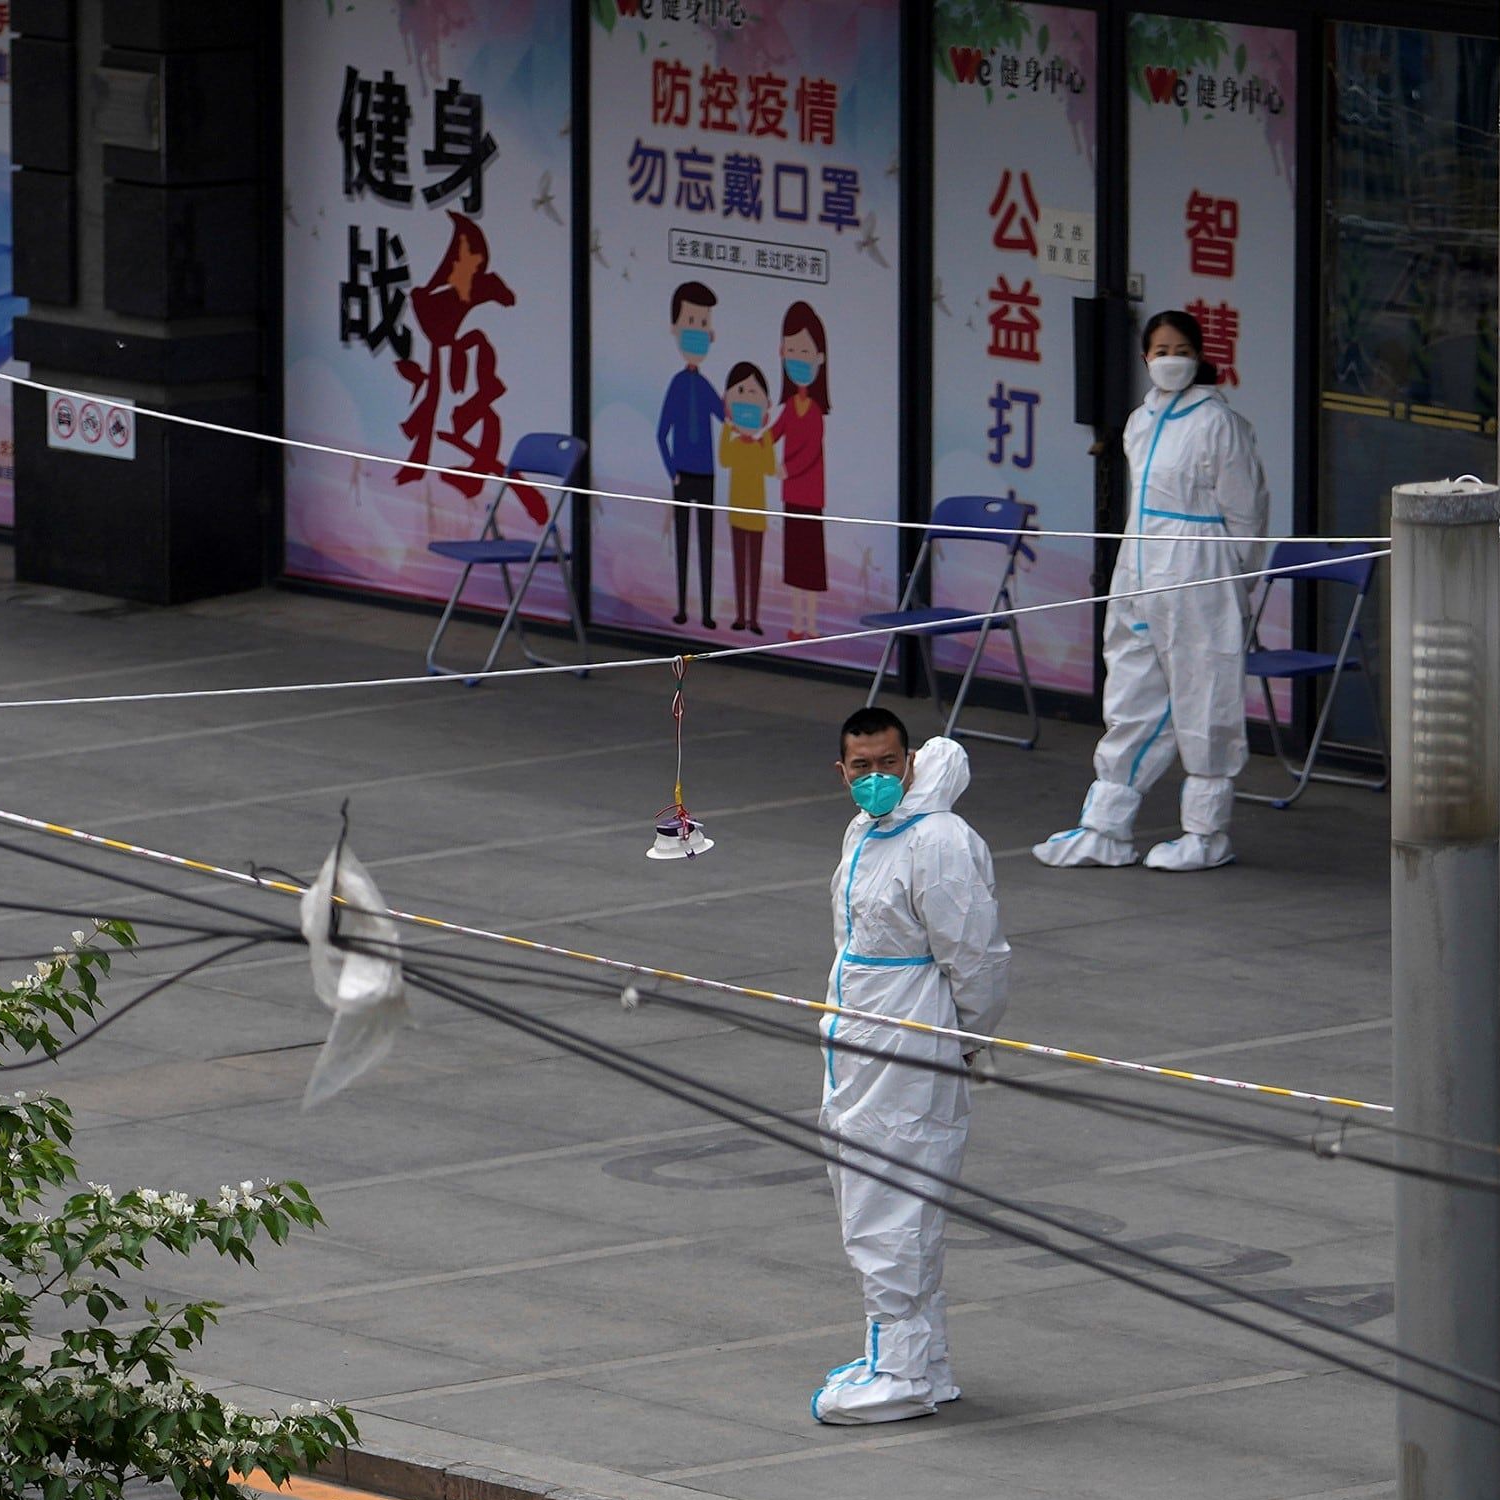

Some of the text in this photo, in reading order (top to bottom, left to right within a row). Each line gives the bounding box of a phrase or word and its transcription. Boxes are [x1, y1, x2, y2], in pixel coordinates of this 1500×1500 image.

[651, 59, 840, 146] 防控疫情
[1000, 54, 1086, 94] 健身中心
[1196, 73, 1285, 115] 健身中心
[337, 64, 499, 213] 健身
[627, 138, 862, 235] 勿忘戴口罩
[1185, 189, 1240, 389] 智慧
